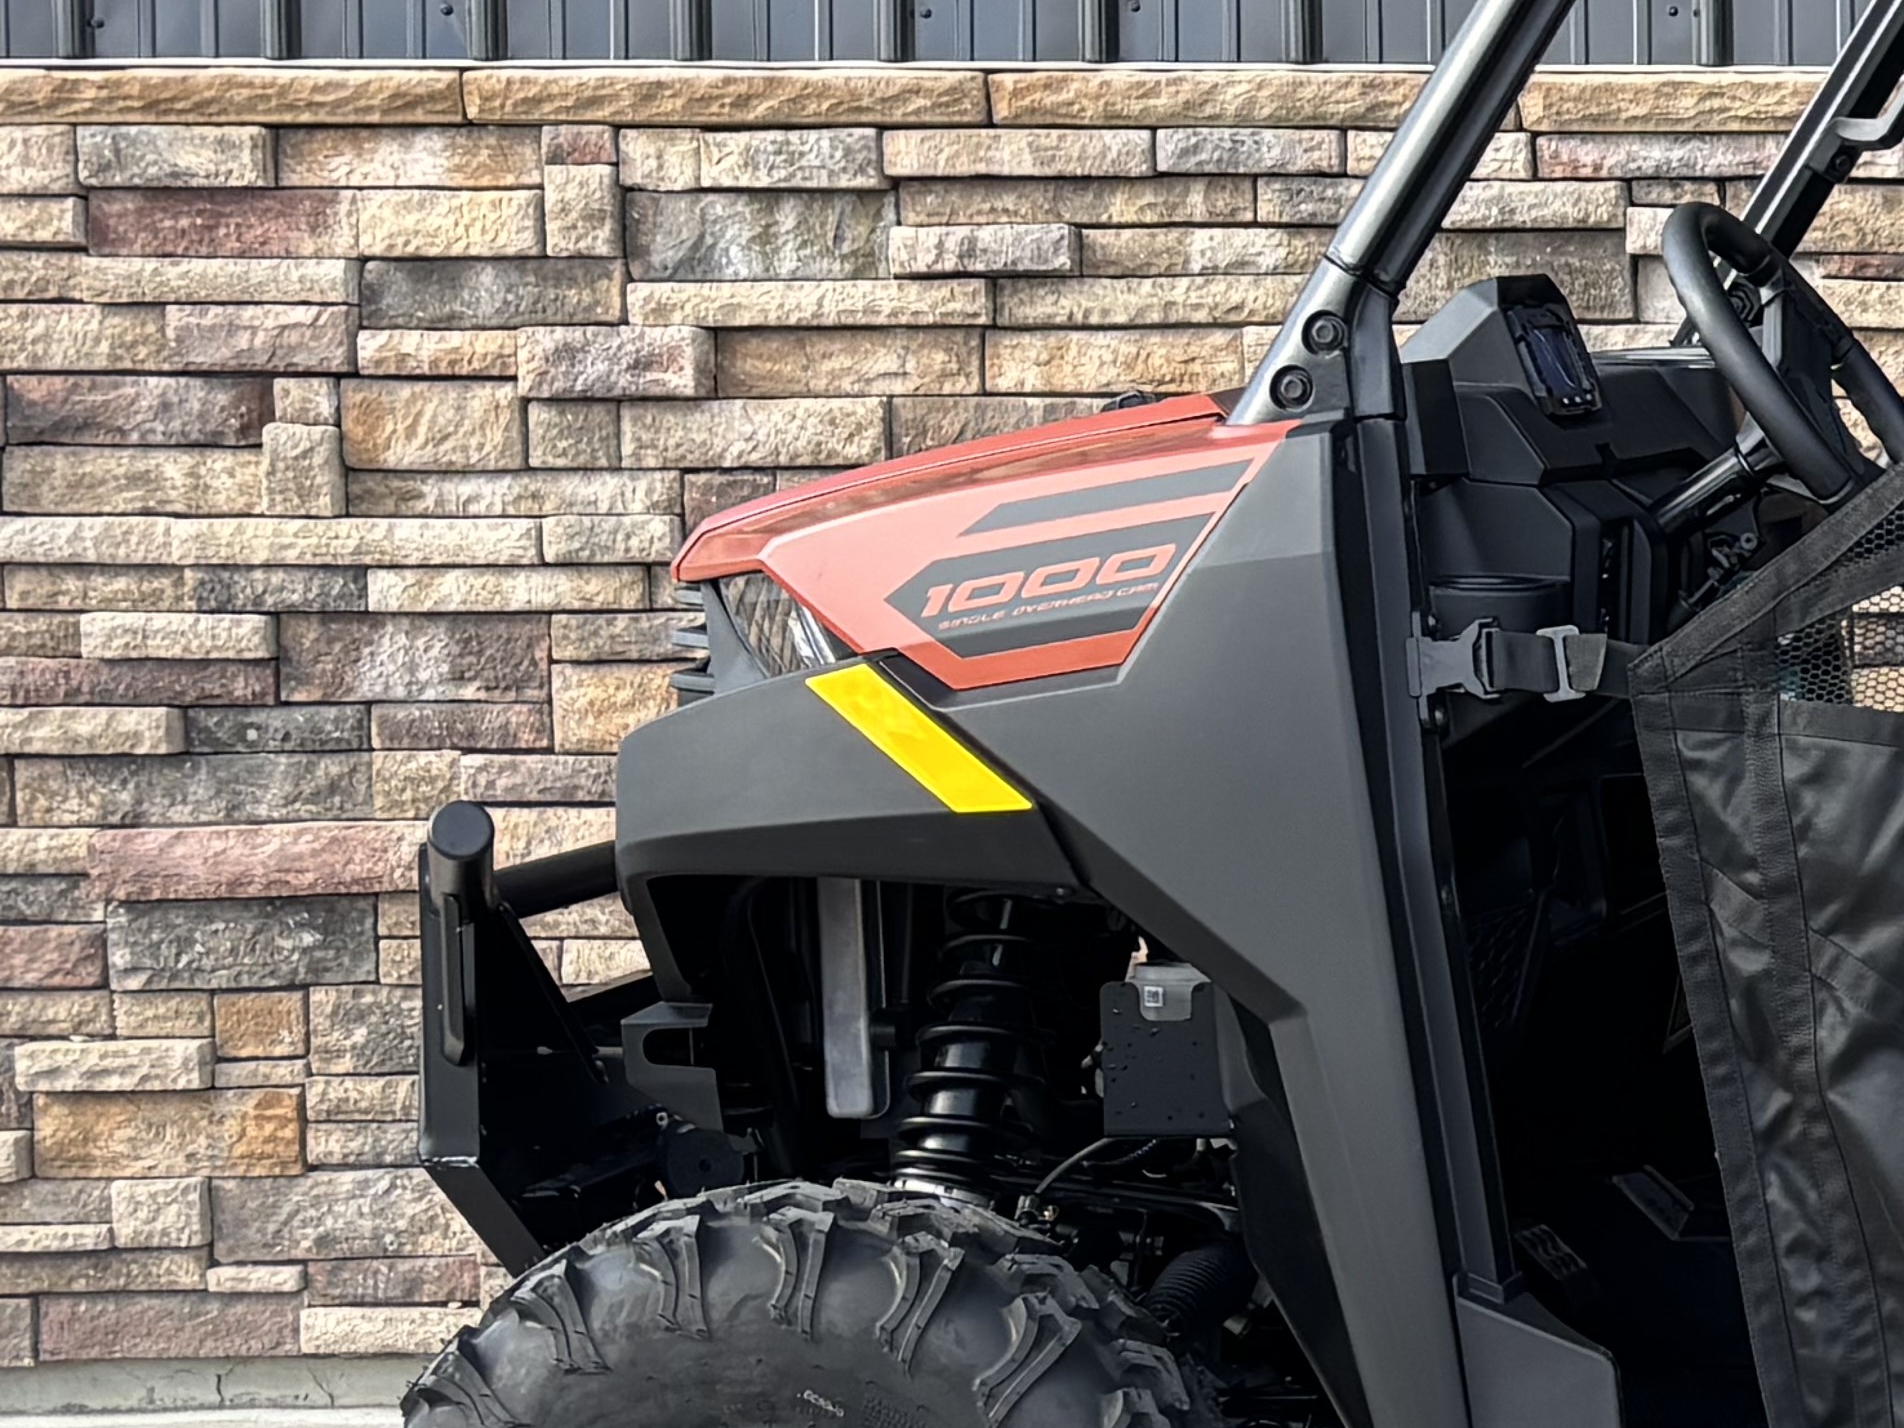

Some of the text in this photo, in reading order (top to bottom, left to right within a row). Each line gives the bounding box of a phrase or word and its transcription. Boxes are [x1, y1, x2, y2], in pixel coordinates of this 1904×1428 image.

[920, 543, 1176, 617] 1000
[938, 610, 1008, 630] SINGLE
[1012, 589, 1113, 617] OVERHEAD
